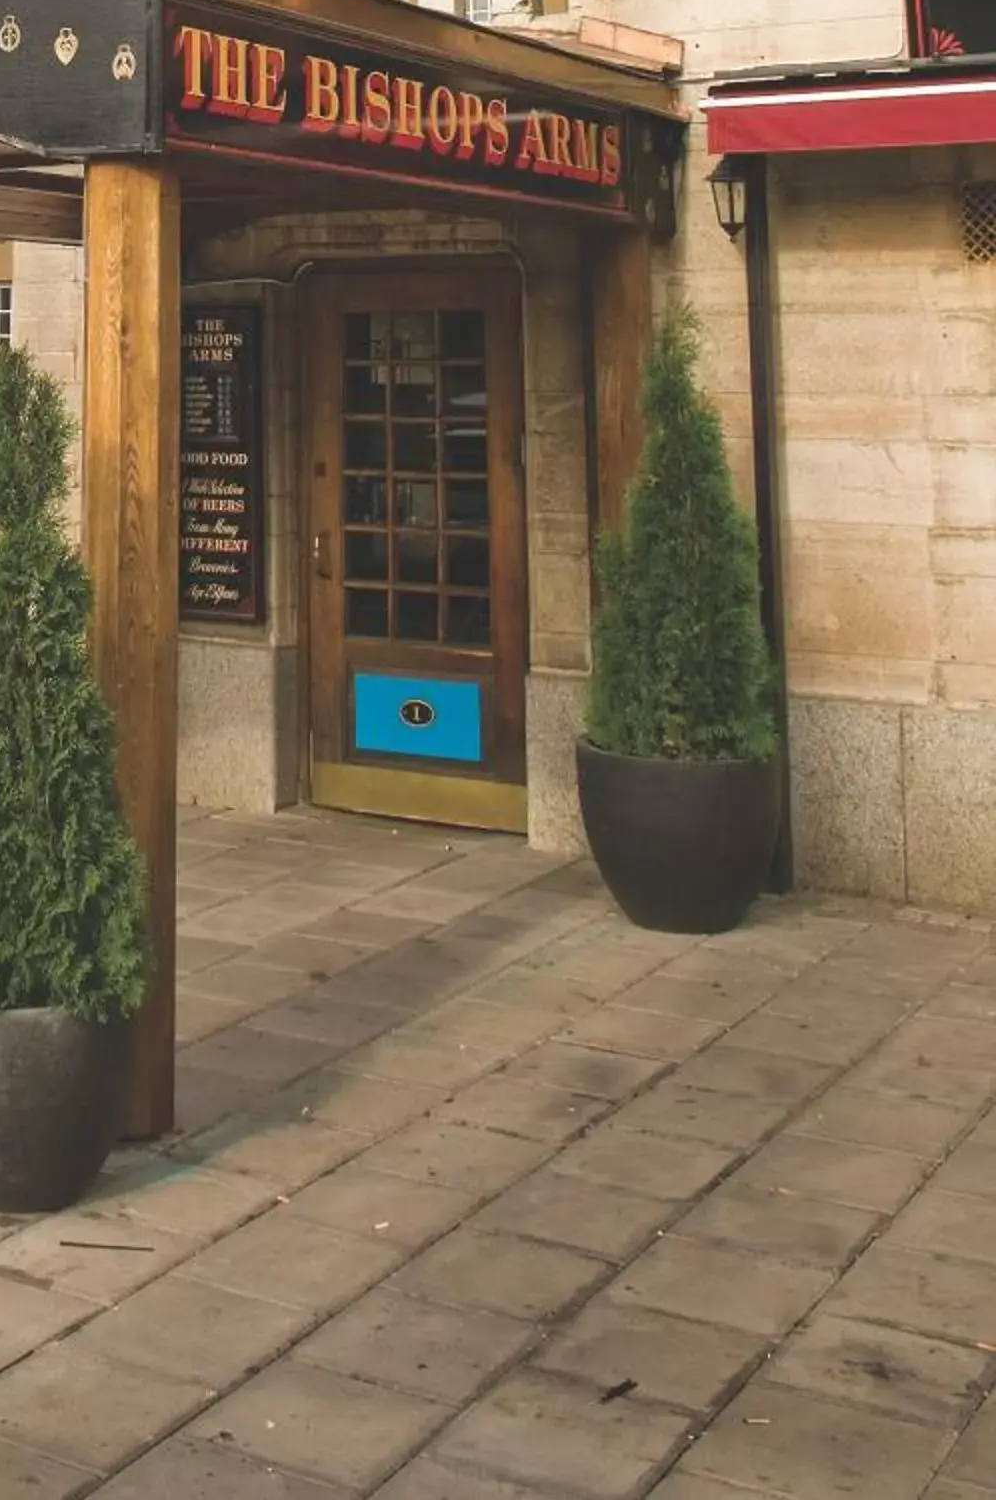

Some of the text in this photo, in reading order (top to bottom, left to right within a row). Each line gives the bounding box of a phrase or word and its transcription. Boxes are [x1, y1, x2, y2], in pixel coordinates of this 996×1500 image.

[174, 25, 621, 185] THE BISHOPS ARMS
[196, 319, 224, 331] THE
[189, 348, 233, 361] ARMS
[212, 453, 248, 466] FOOD
[182, 537, 248, 552] IFFERENT
